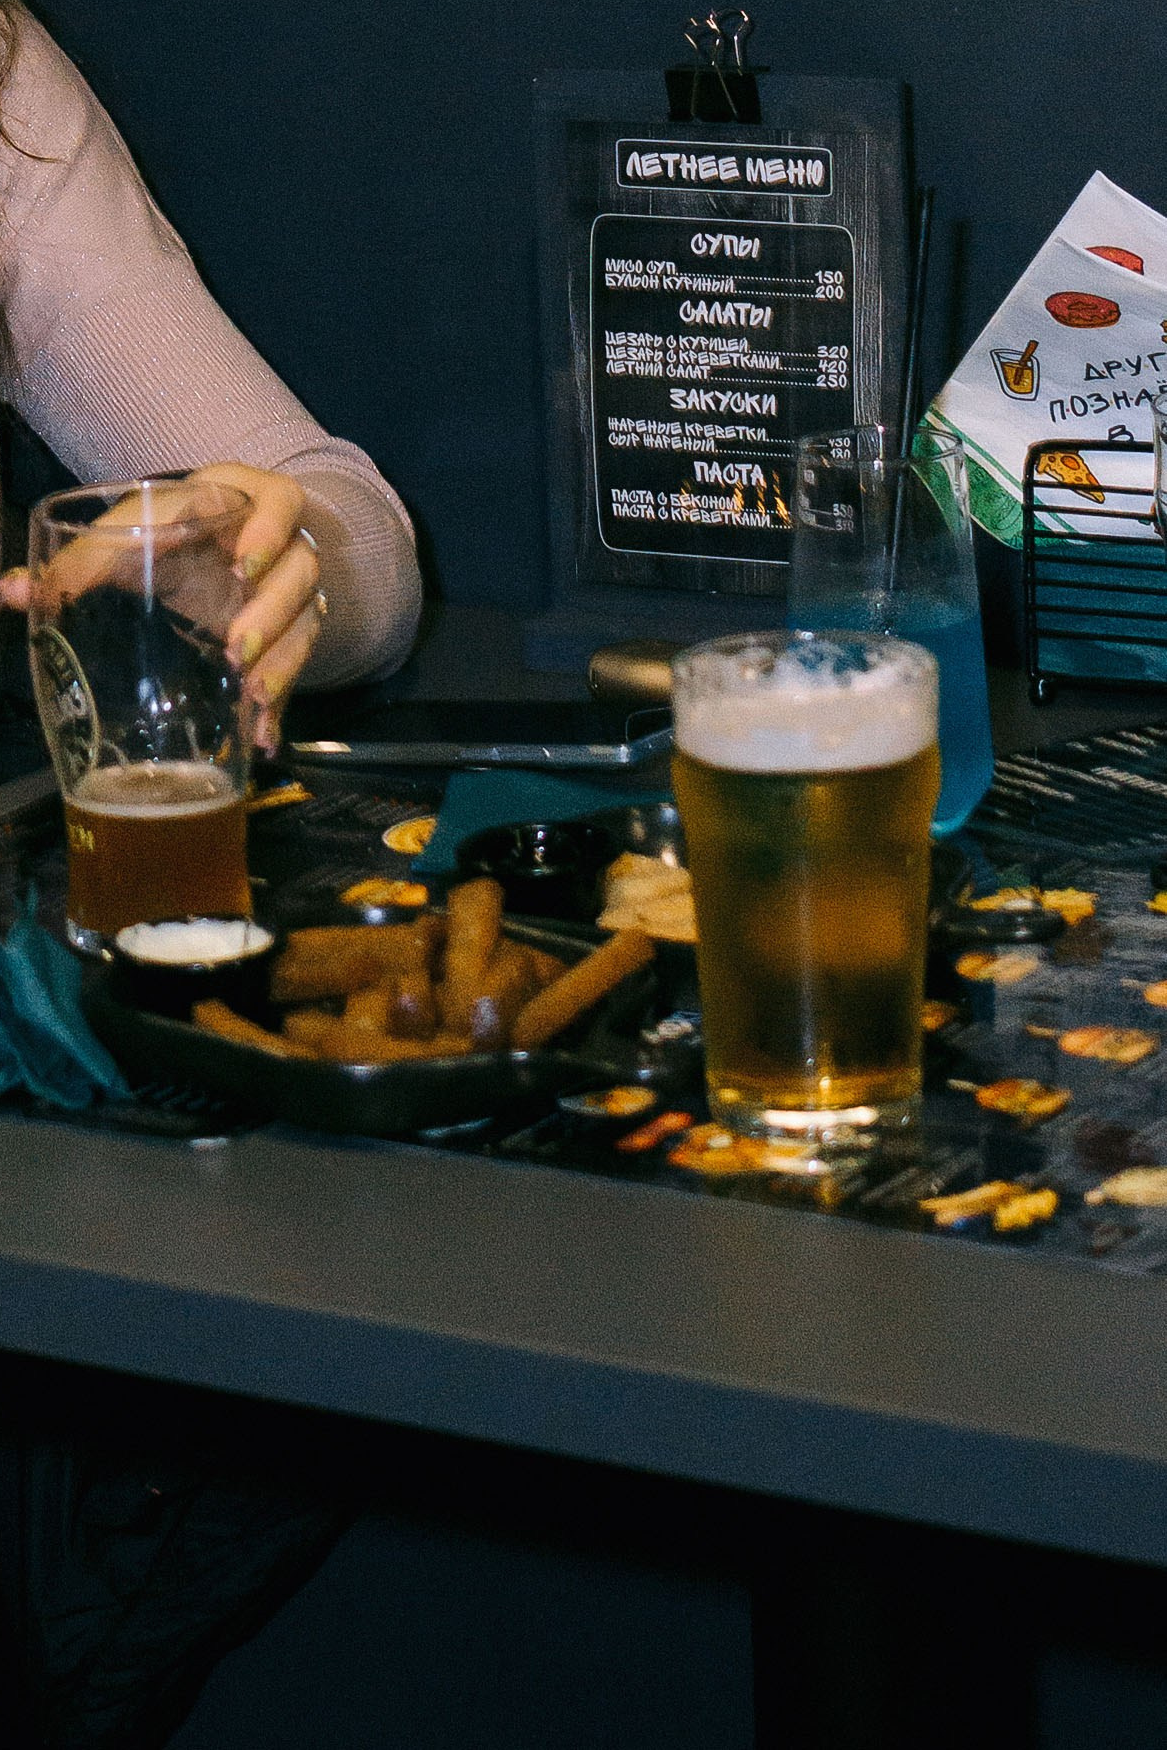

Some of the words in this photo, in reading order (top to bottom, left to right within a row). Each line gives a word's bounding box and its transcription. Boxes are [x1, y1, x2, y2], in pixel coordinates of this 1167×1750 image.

[626, 151, 740, 181] ЛЕТНЕЕ
[746, 157, 824, 187] МЕНЮ
[690, 233, 760, 258] СУПЫ
[605, 258, 642, 273] МИСО
[646, 260, 676, 275] СУП
[815, 270, 843, 285] 150
[605, 274, 659, 289] БУЛЬОН
[663, 276, 735, 293] КУРИНЫЙ
[815, 285, 844, 299] 200
[679, 300, 772, 328] САЛАТЫ
[605, 331, 662, 347] ЦЕЗАРЬ
[666, 335, 676, 349] С
[817, 345, 848, 360] 320
[605, 346, 662, 362] ЦЕЗАРЬ
[666, 350, 676, 364] С
[679, 350, 780, 370] КРЕВЕТКАМИ
[818, 360, 847, 374] 420
[666, 364, 711, 380] САЛАТ
[816, 375, 847, 388] 250
[670, 388, 777, 416] ЗАКУСКИ
[608, 417, 682, 435] ЖАРЕНЫЕ
[685, 422, 767, 441] КРЕВЕТКИ
[608, 433, 642, 447] СЫР
[694, 461, 766, 486] ПАСТА
[611, 488, 654, 504] ПАСТА
[658, 491, 668, 505] С
[670, 493, 738, 511] БЕКОНОМ
[612, 503, 655, 519] ПАСТА
[658, 507, 668, 521] С
[671, 508, 771, 528] КРЕВЕТКАМИ
